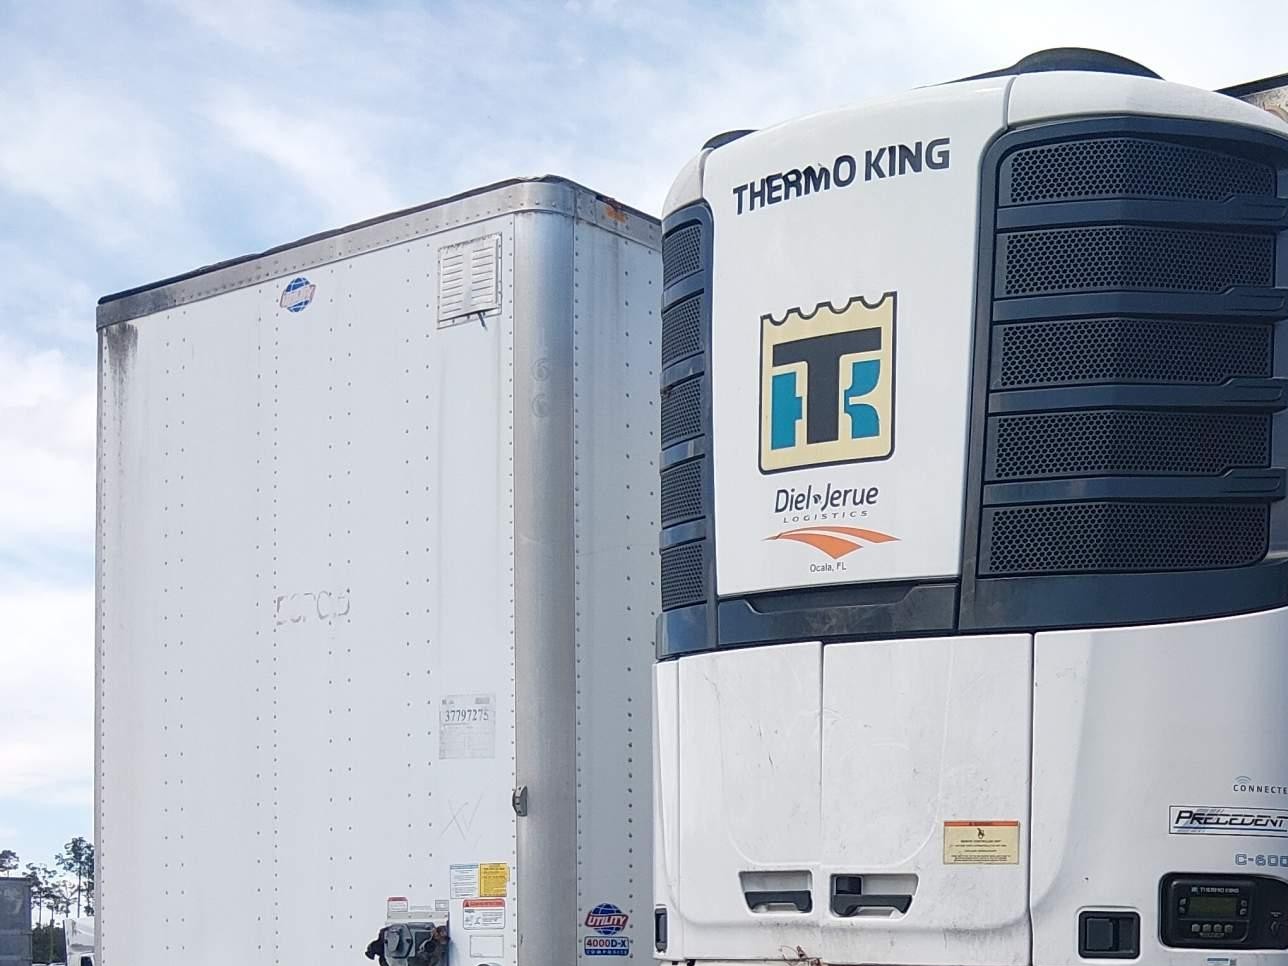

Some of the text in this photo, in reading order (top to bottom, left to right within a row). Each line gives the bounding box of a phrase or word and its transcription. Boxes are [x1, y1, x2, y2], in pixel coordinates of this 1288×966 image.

[732, 137, 951, 216] THERMO KING
[774, 482, 879, 513] Diel Jerue
[783, 510, 869, 524] LOGISTICS
[809, 561, 847, 574] Ocala, FL
[587, 915, 626, 926] UTILITY
[586, 938, 627, 948] 4000D-X
